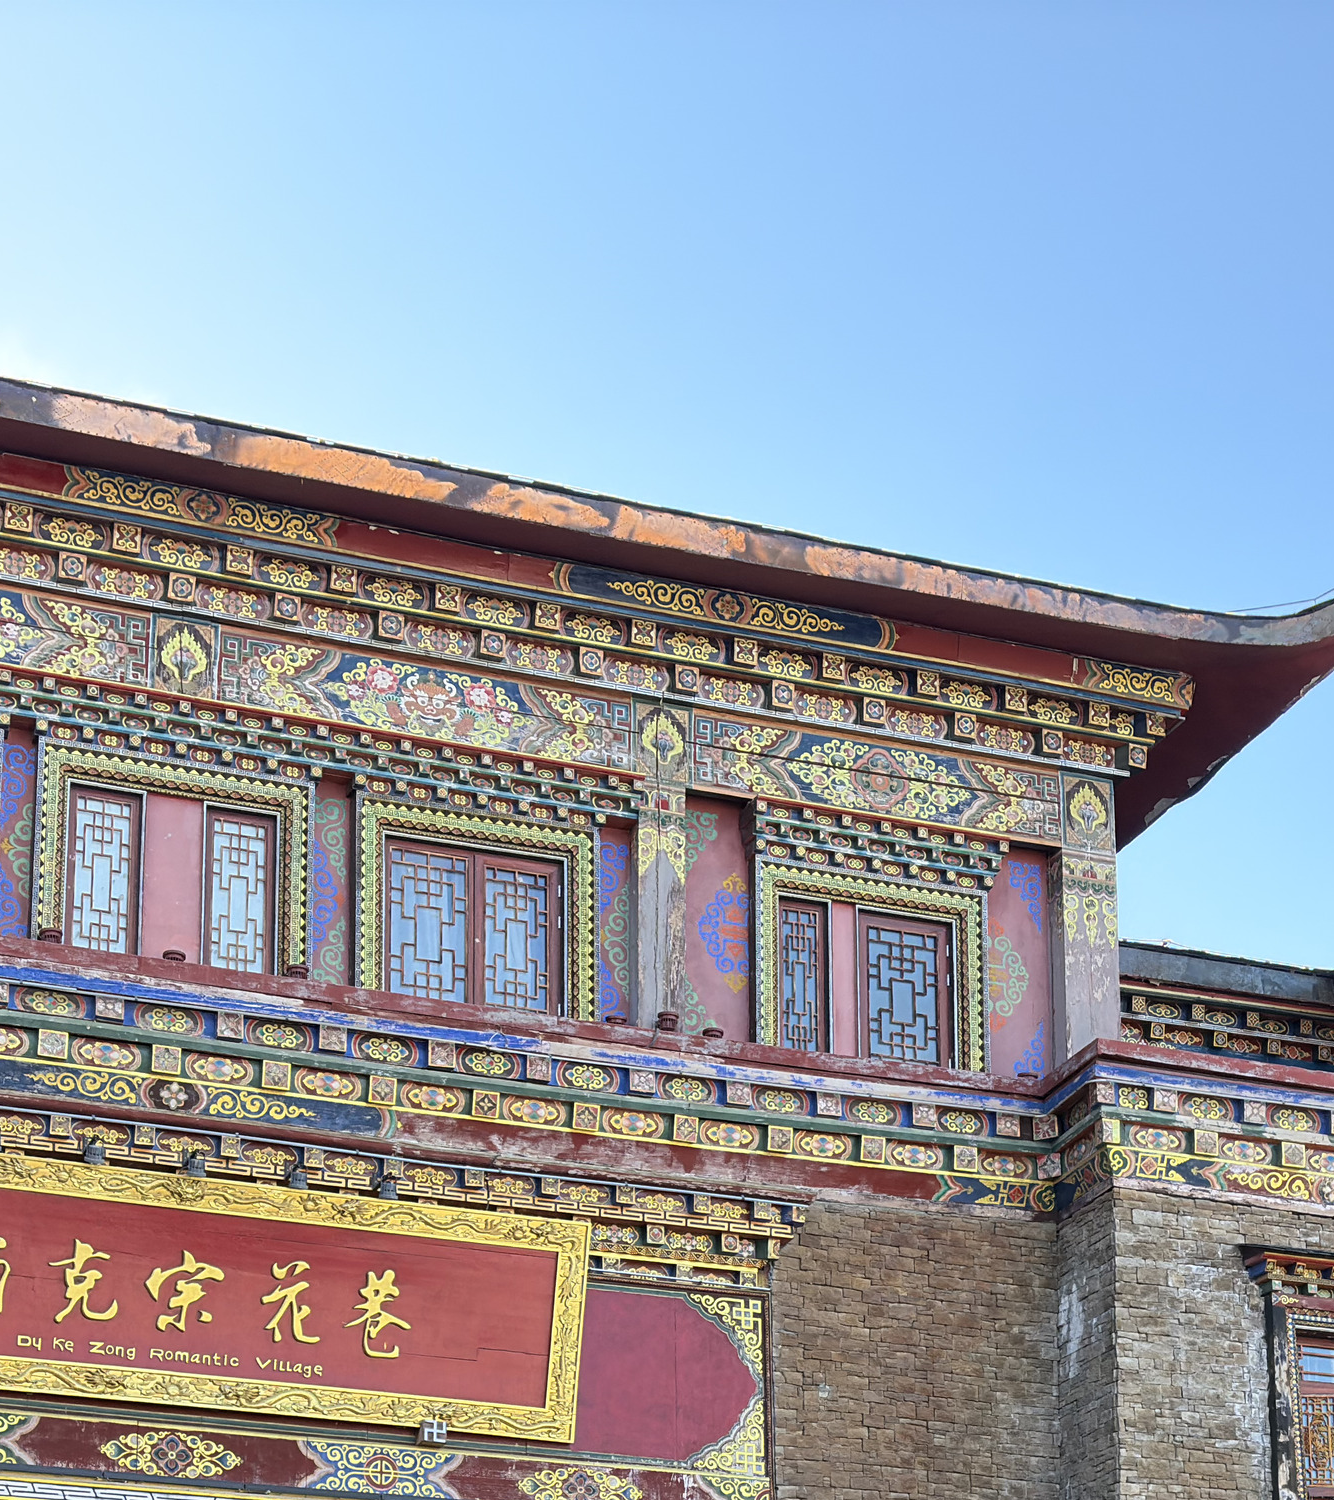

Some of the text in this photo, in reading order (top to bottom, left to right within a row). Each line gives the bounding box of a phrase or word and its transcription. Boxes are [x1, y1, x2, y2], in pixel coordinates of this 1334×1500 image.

[52, 1337, 75, 1354] Ke
[88, 1340, 138, 1361] Zong
[149, 1348, 240, 1368] Romantic
[255, 1355, 325, 1378] Village
